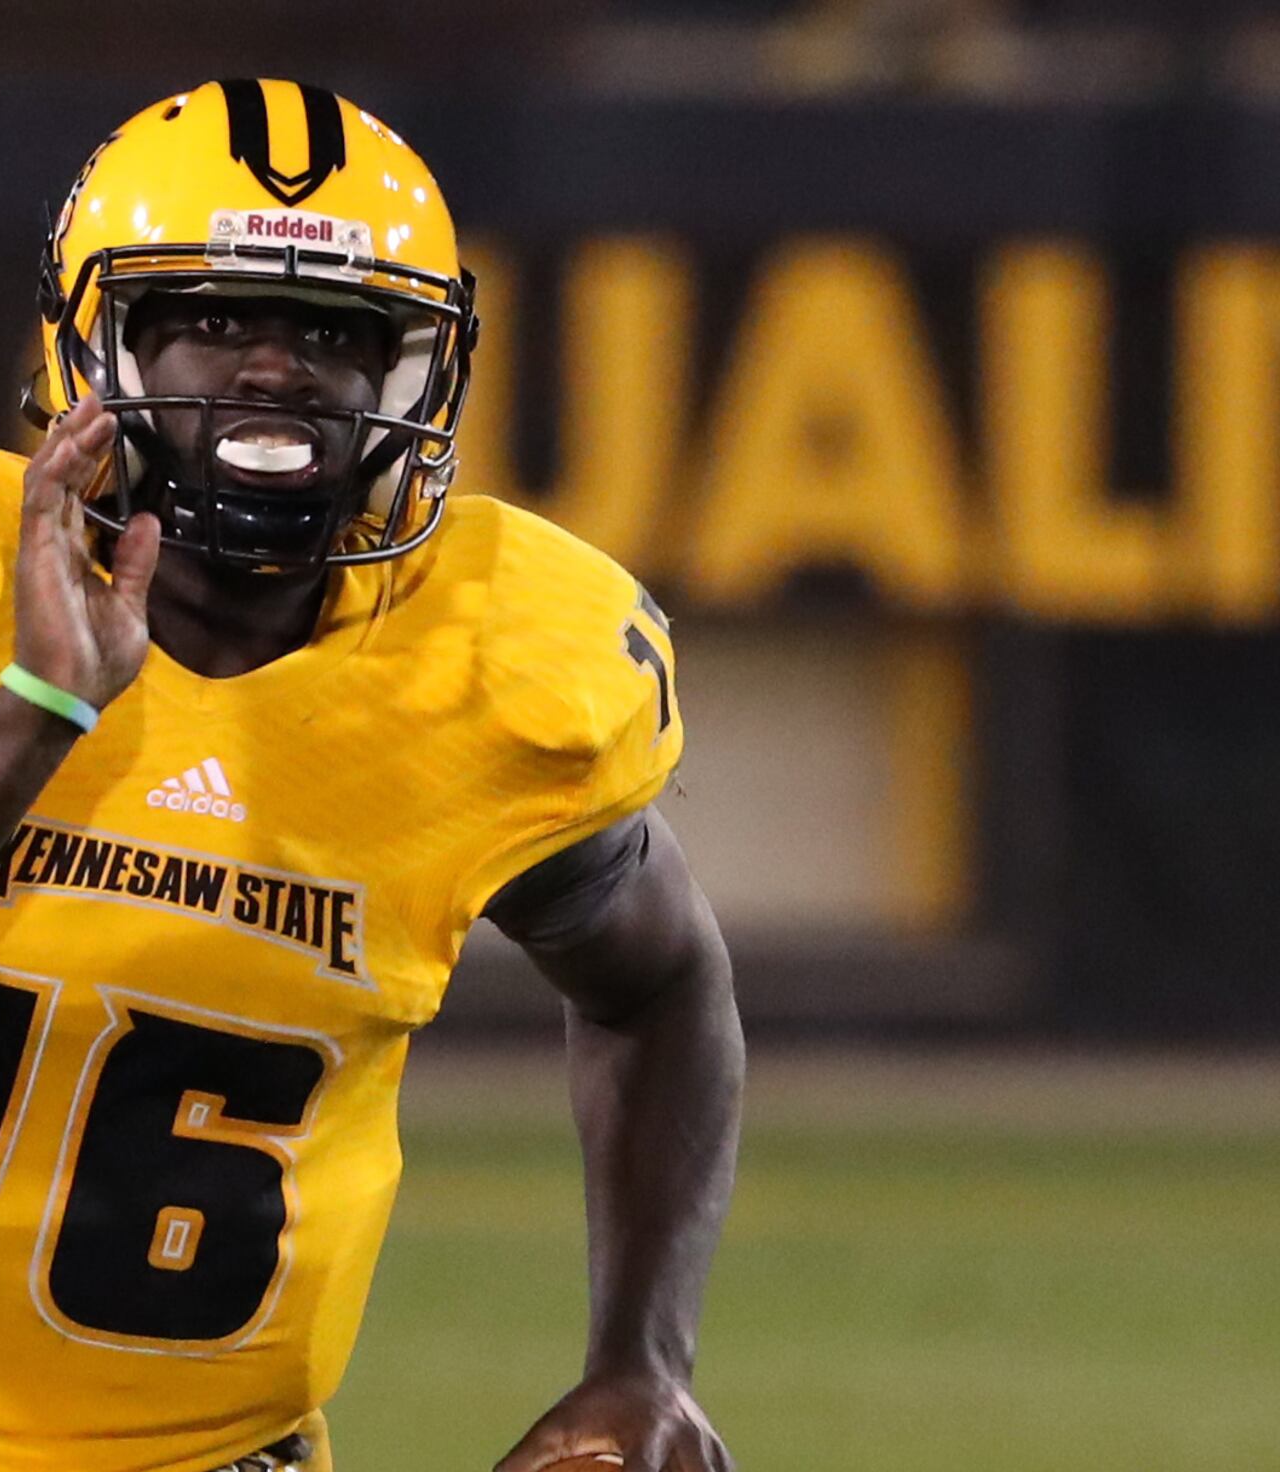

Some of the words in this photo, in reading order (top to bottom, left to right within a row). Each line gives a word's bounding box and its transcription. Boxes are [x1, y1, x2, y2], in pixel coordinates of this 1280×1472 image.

[247, 214, 333, 242] Riddell
[146, 787, 247, 822] adidas
[233, 872, 358, 975] STATE
